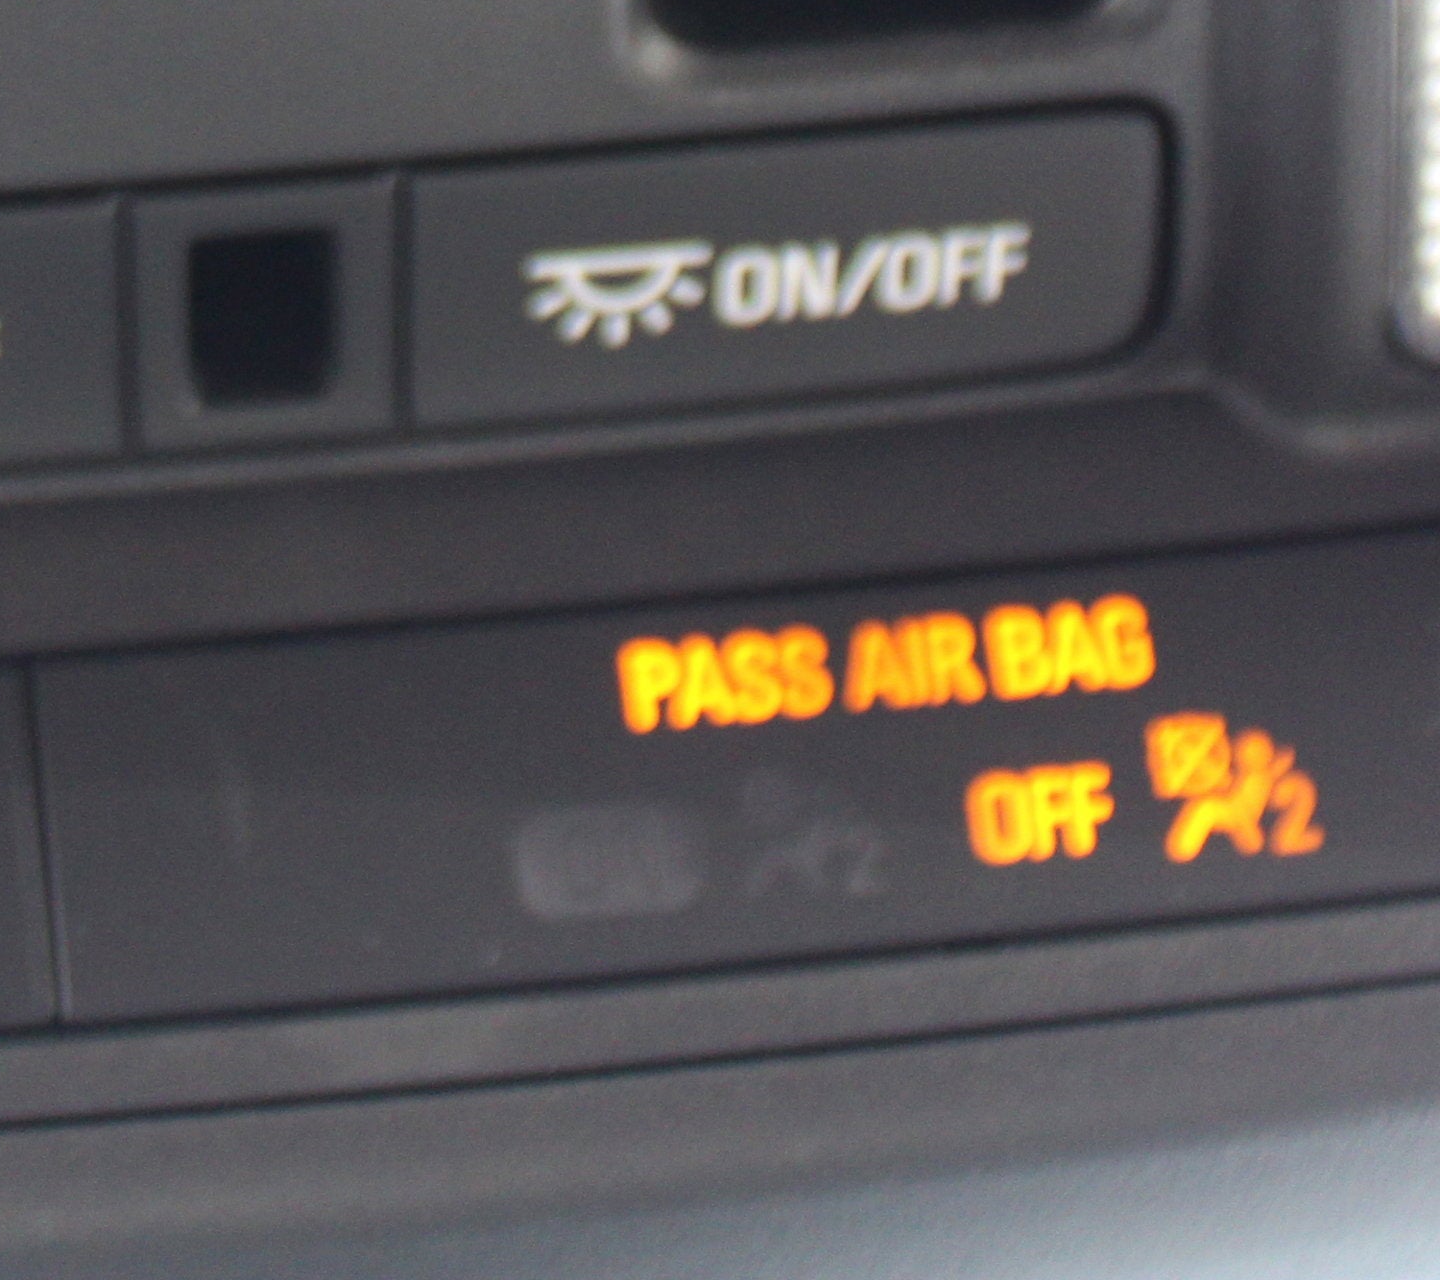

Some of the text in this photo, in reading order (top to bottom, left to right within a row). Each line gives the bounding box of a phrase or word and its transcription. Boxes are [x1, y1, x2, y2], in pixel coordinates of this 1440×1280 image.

[718, 223, 1030, 327] ON/OFF
[617, 593, 1155, 732] PASS AIR BAG
[966, 762, 1325, 864] OFF 2
